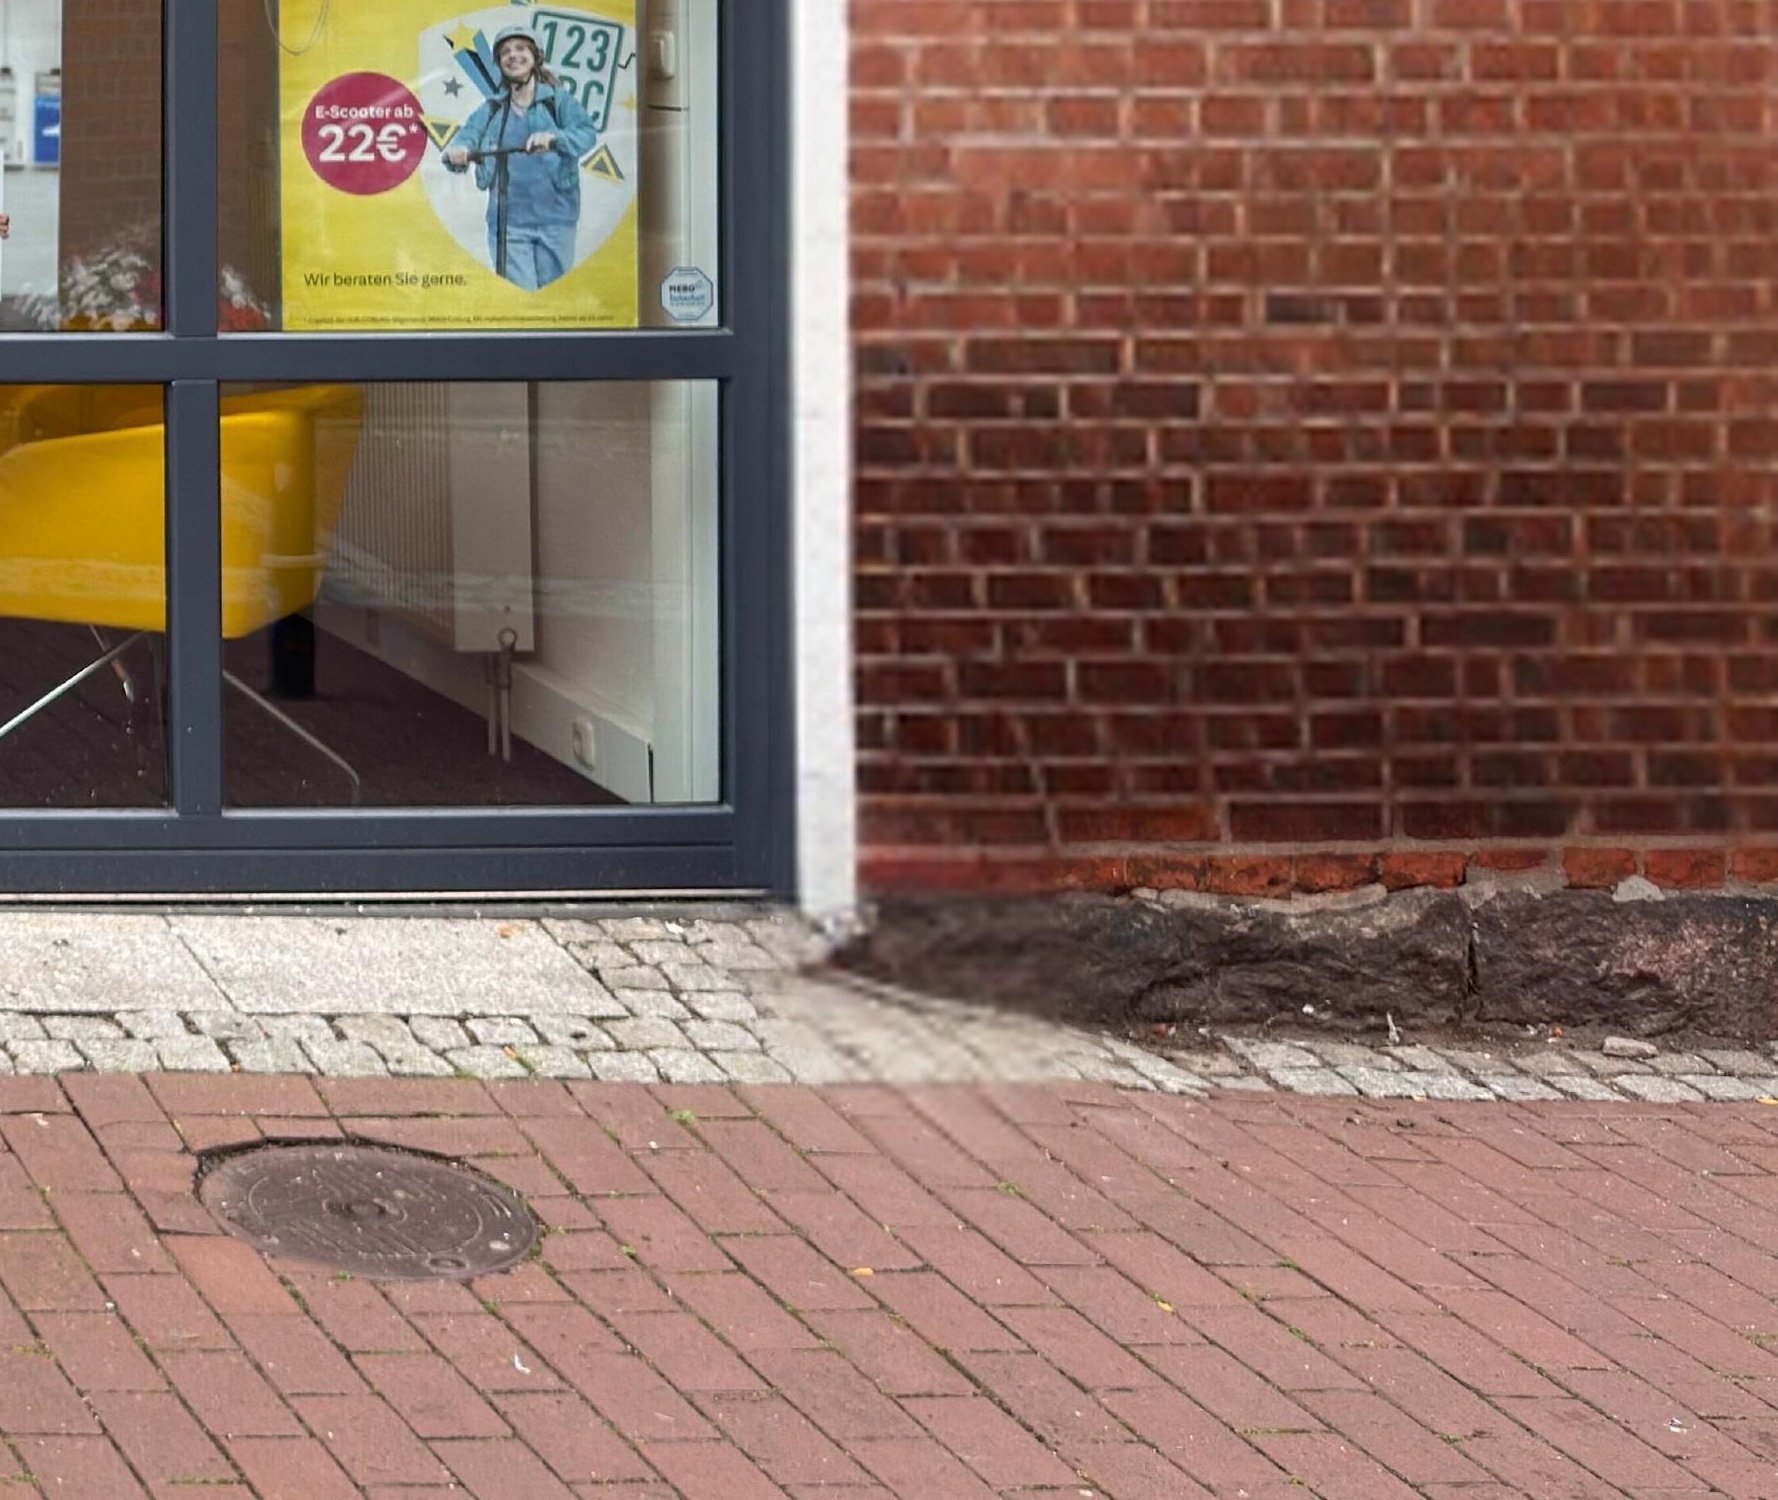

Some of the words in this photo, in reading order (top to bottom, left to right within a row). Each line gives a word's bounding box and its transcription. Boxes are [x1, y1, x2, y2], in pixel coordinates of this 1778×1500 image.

[543, 21, 610, 72] 123
[315, 105, 390, 119] E-Scooter
[394, 105, 414, 118] ab
[304, 273, 328, 287] Wir
[333, 273, 391, 286] beraten
[395, 273, 418, 285] Sie
[421, 275, 467, 288] gerne.
